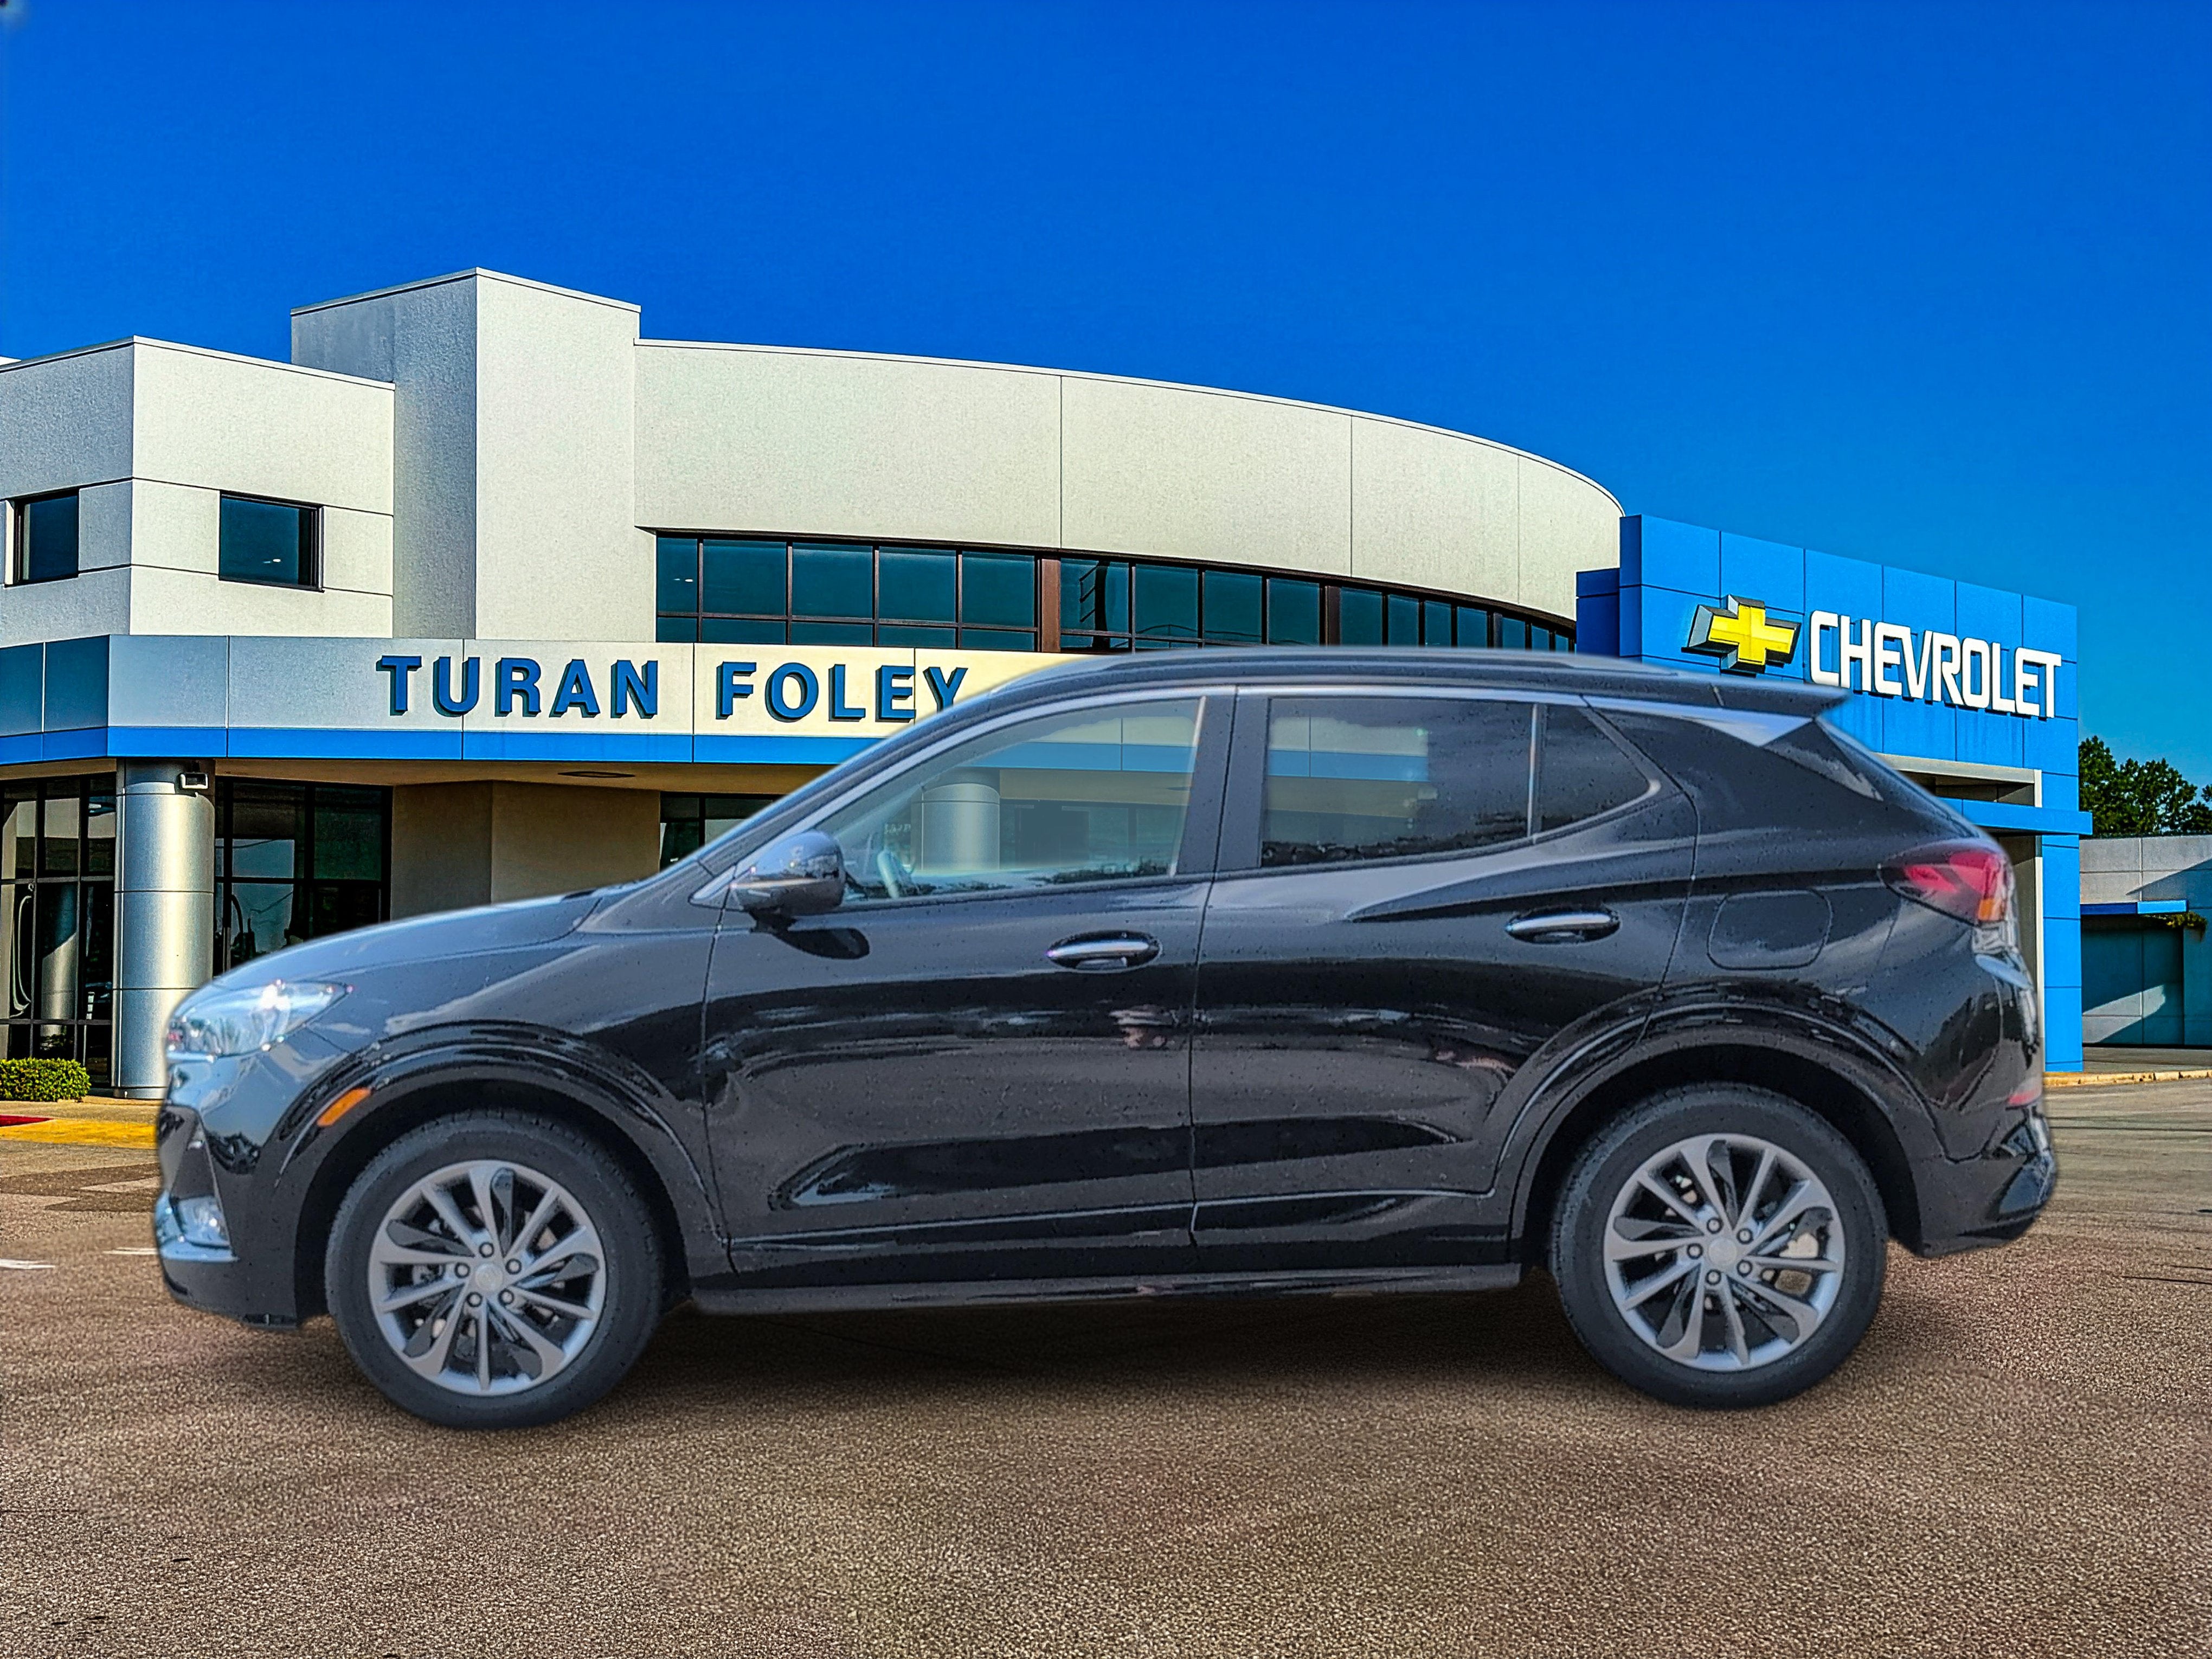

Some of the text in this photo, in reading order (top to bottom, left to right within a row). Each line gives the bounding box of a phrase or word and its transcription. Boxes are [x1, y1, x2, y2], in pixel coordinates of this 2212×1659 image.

[375, 655, 968, 723] TURAN FOLEY
[1810, 610, 2062, 718] CHEVROLET
